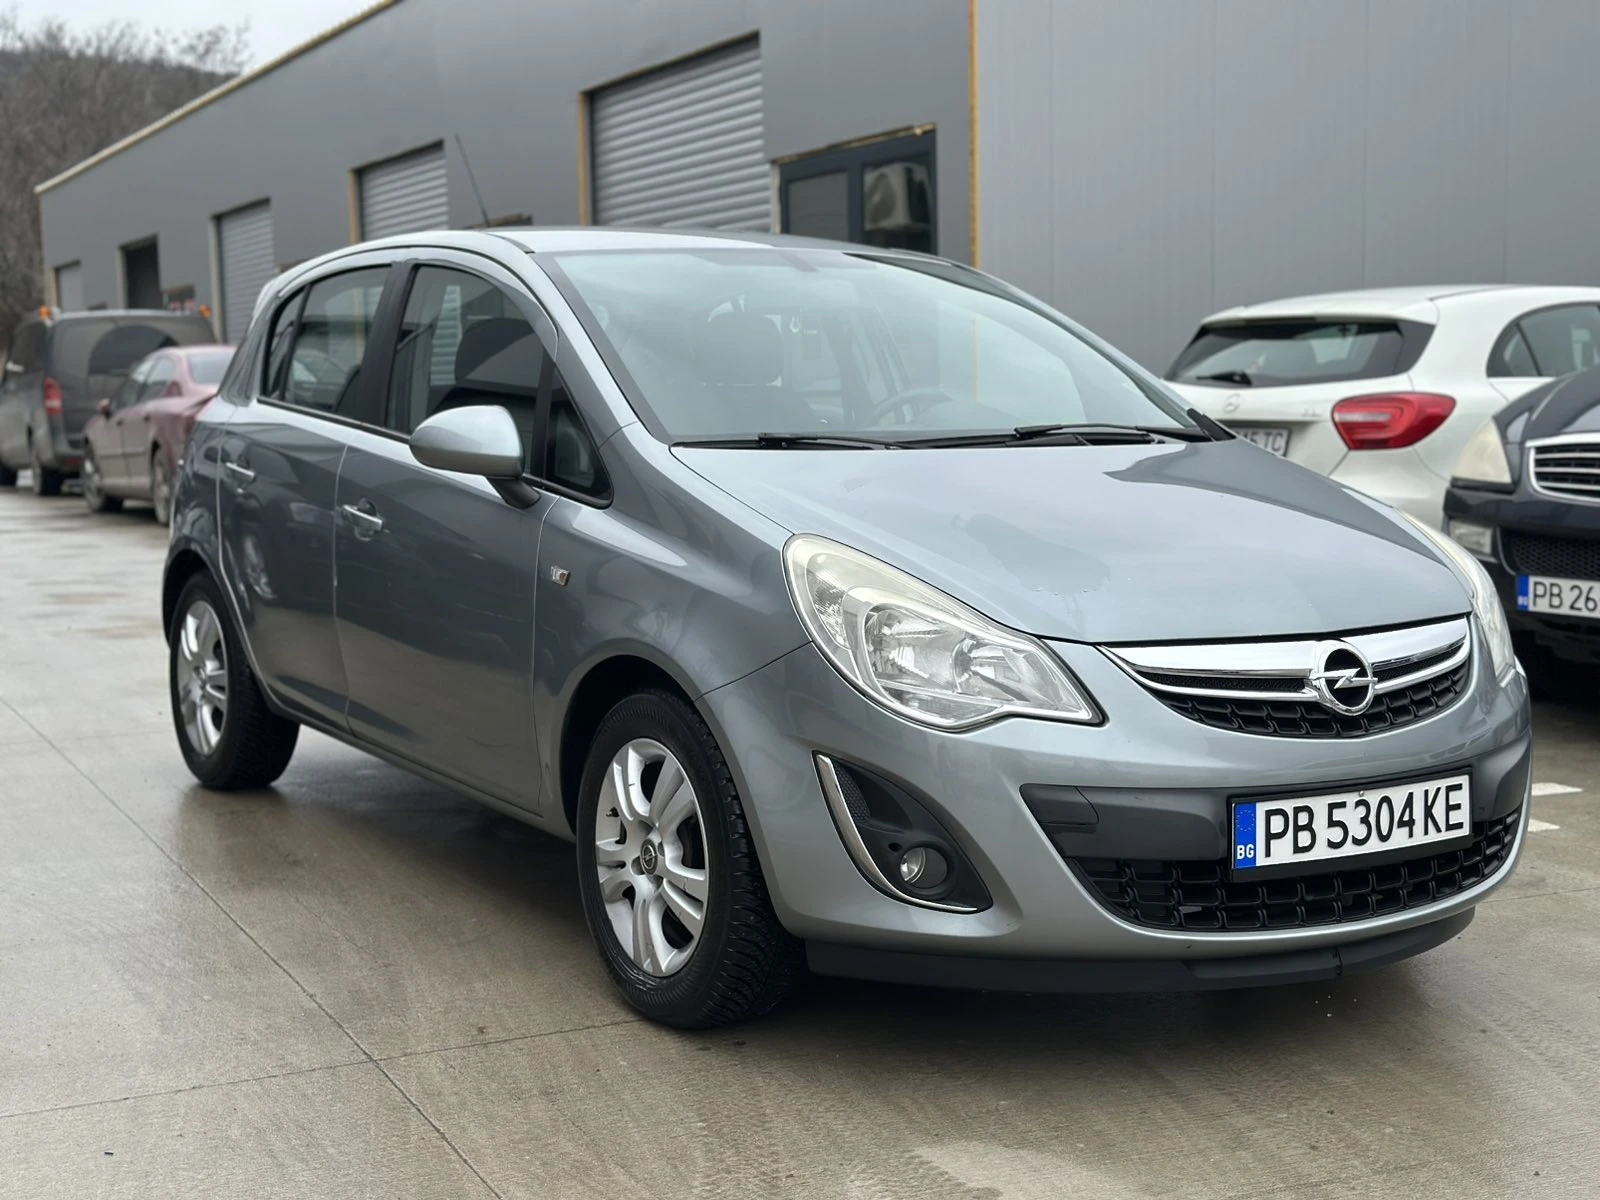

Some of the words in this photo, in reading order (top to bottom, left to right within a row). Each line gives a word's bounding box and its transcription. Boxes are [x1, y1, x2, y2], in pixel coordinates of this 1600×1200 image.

[1533, 581, 1563, 609] PB
[1569, 585, 1598, 612] 26
[1264, 805, 1317, 858] PB
[1327, 792, 1416, 850] 5304
[1423, 783, 1464, 836] KE
[1236, 844, 1254, 860] BG
